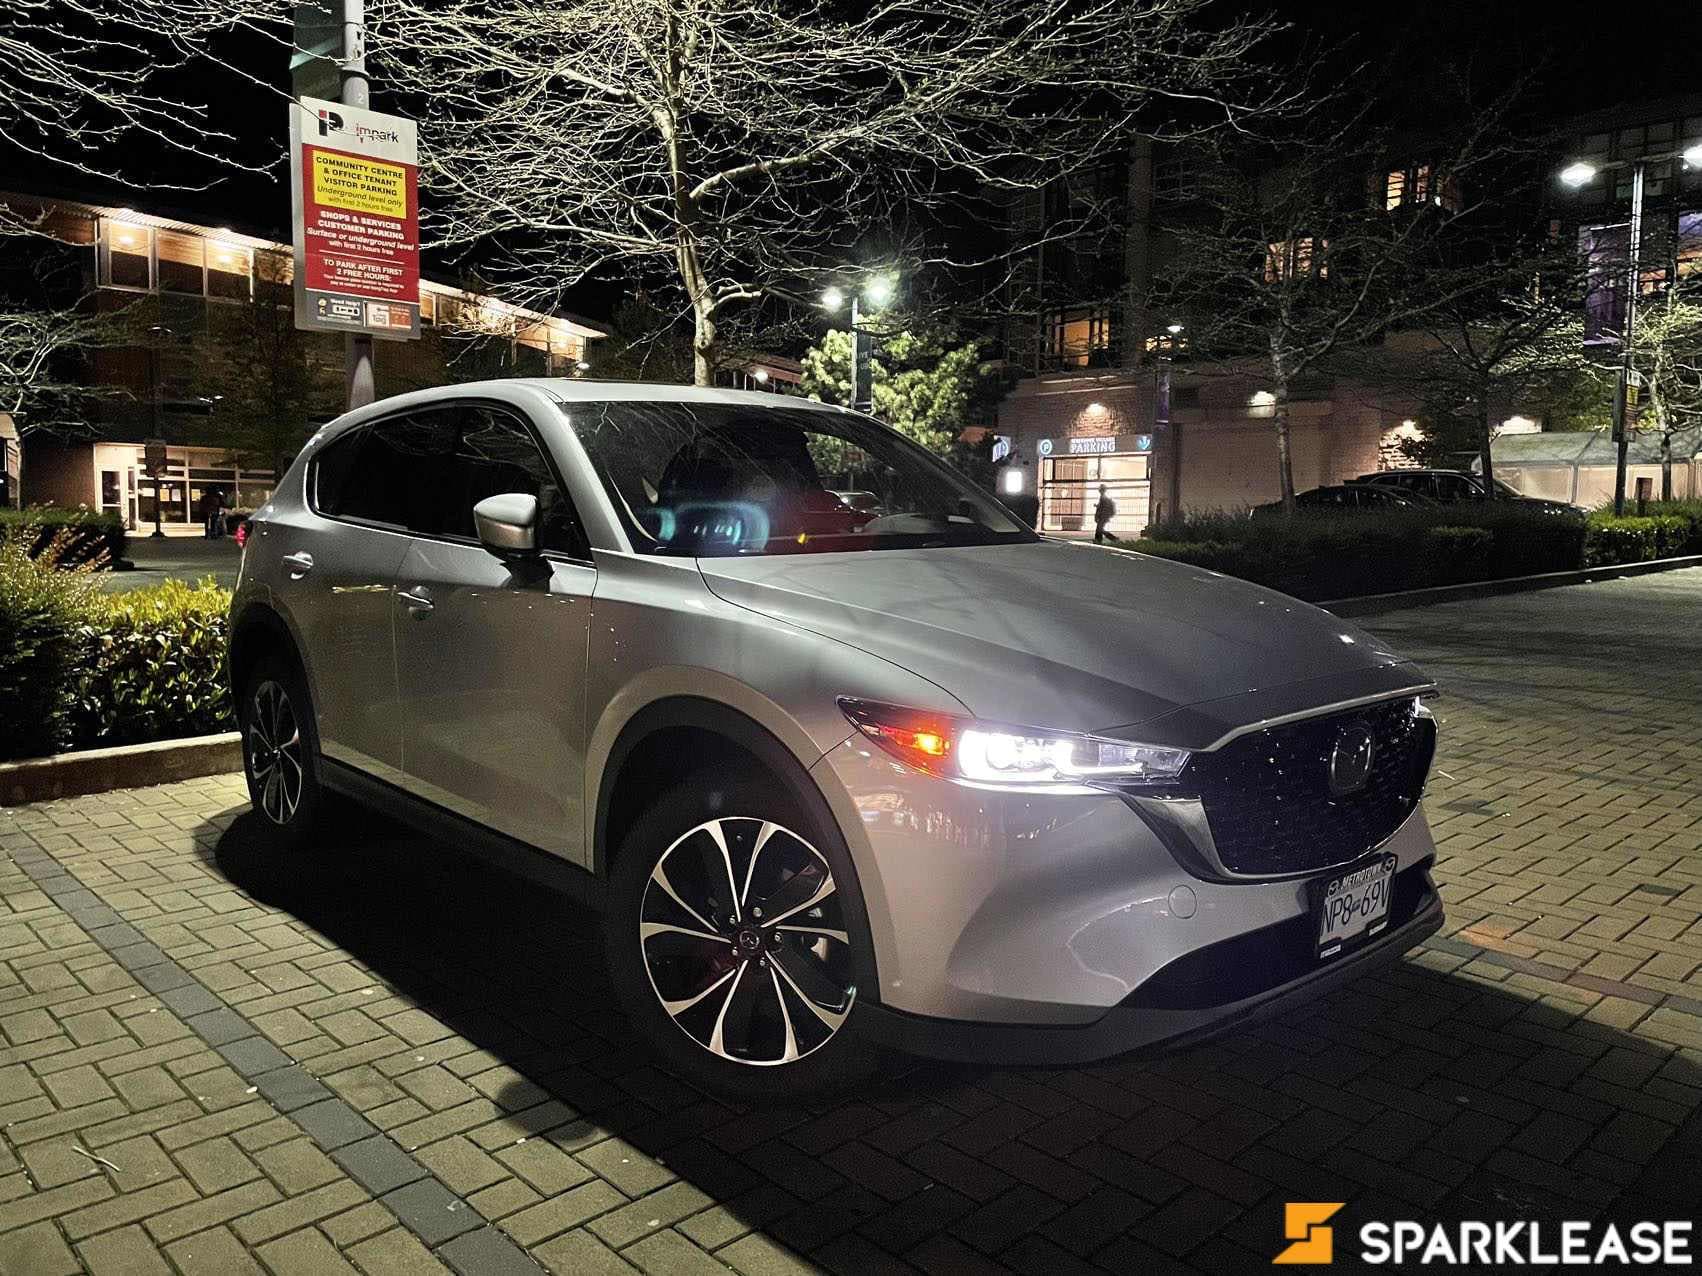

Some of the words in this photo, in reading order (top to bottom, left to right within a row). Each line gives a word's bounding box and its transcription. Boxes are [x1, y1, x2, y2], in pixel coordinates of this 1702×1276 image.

[316, 156, 368, 172] COMMUNITY
[371, 167, 403, 179] CENTRE
[324, 177, 358, 189] VISITOR
[361, 184, 397, 196] PARKING
[332, 169, 362, 180] OFFICE
[364, 175, 398, 187] TENANT
[317, 186, 367, 200] Underground
[368, 194, 386, 204] level
[387, 198, 403, 208] only
[318, 219, 365, 234] CUSTOMER
[367, 228, 405, 240] PARKING
[320, 210, 350, 222] SHOPS
[352, 215, 359, 223] &
[361, 217, 402, 230] SERVICES
[306, 227, 337, 239] Surface
[338, 233, 347, 241] or
[348, 233, 396, 249] underground
[397, 241, 415, 251] level
[323, 258, 335, 266] TO
[336, 260, 357, 269] PARK
[358, 263, 382, 273] AFTER
[383, 267, 404, 276] FIRST
[343, 269, 363, 278] FREE
[1071, 441, 1116, 453] PARKING
